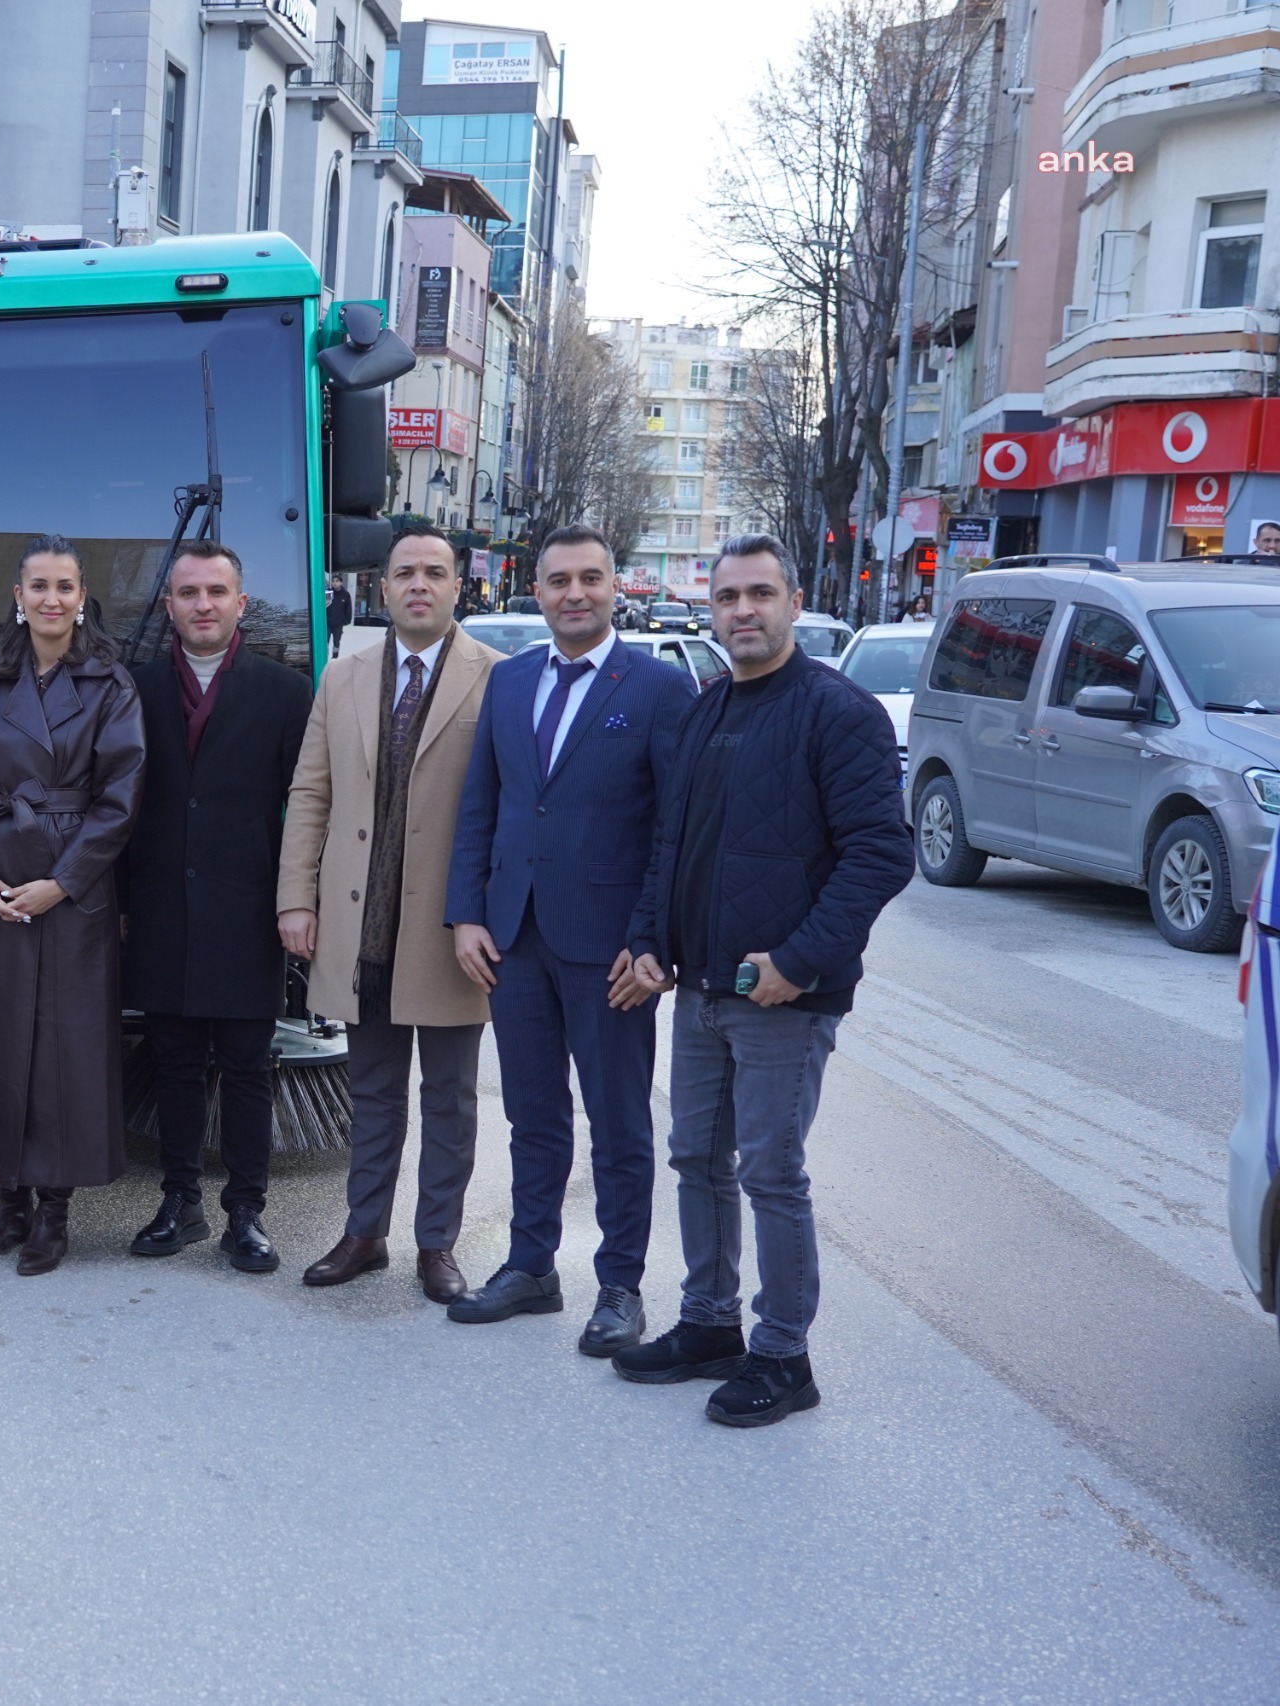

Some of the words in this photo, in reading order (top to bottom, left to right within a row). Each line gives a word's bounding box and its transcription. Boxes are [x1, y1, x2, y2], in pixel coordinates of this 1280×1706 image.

[454, 59, 494, 69] Çağatay
[497, 58, 530, 67] ERSAN
[1185, 503, 1225, 513] vodafone
